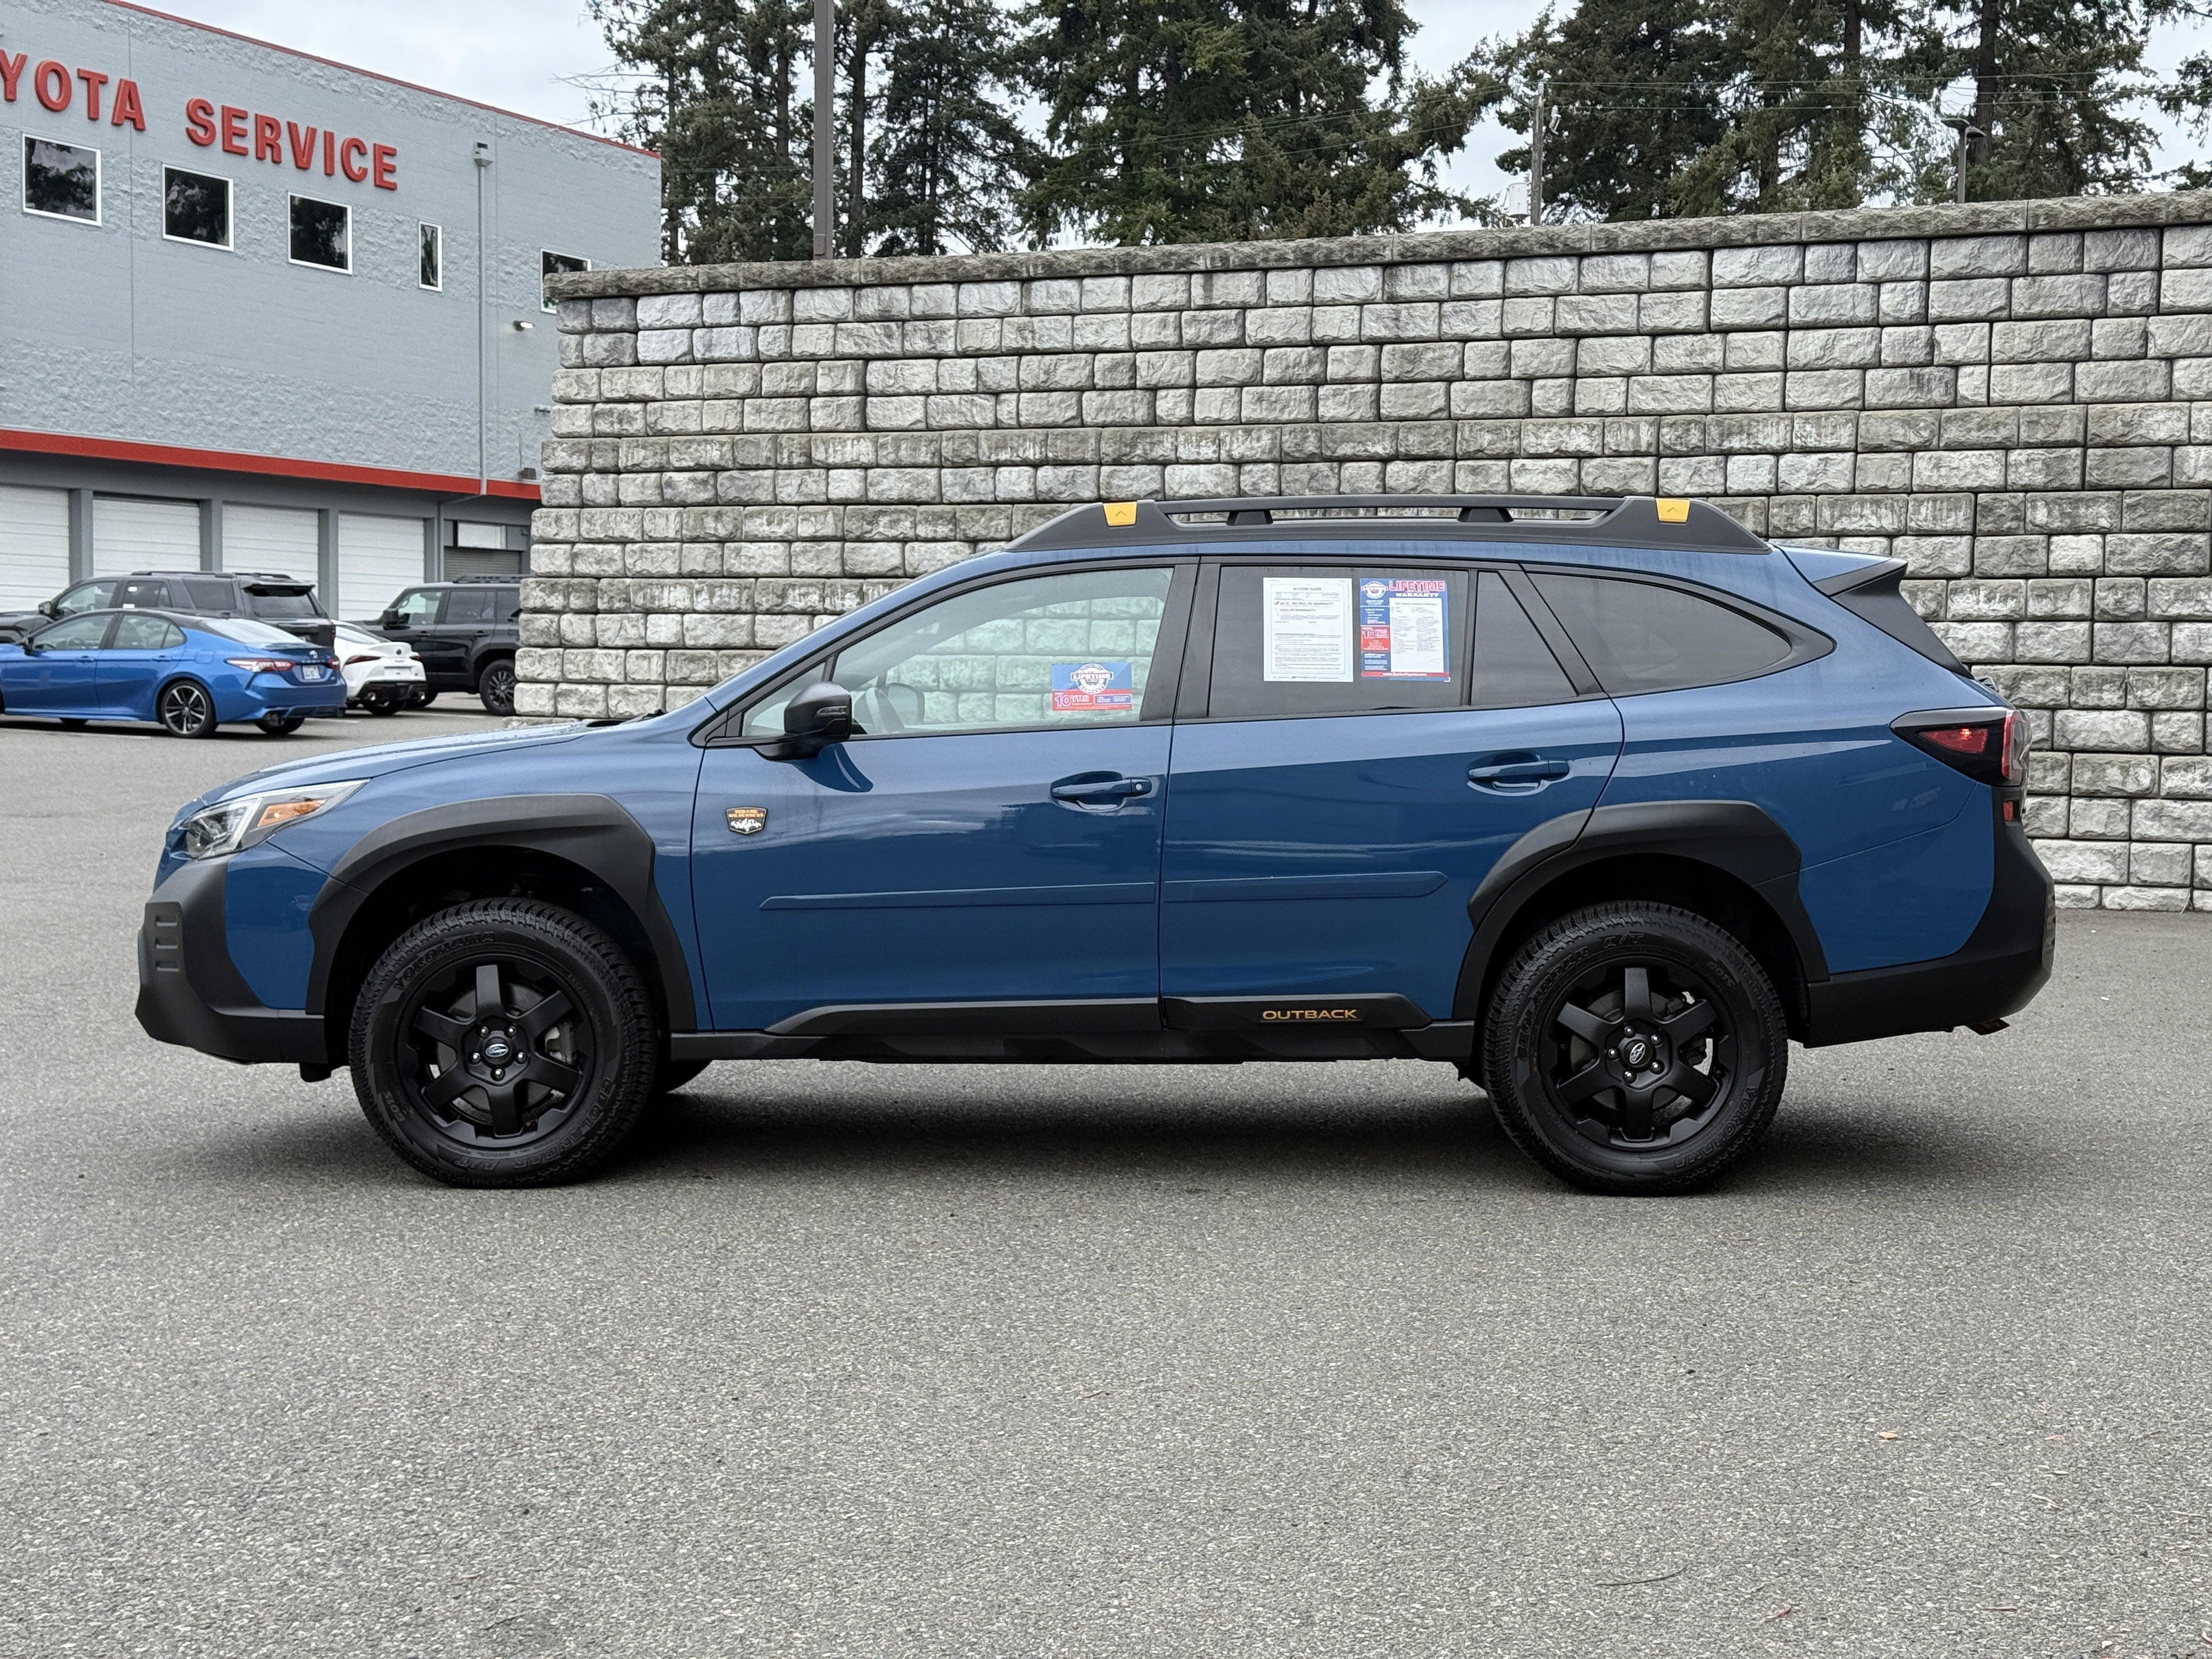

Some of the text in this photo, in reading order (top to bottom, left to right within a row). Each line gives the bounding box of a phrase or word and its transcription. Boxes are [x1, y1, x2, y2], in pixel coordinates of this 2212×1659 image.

[185, 97, 398, 191] SERVICE
[1389, 580, 1446, 591] LIFETIME
[1363, 629, 1377, 639] 10
[1055, 695, 1071, 707] 10
[393, 931, 495, 990] YOKOHAMA
[1262, 1009, 1358, 1020] OUTBACK
[1517, 932, 1645, 1062] GEOLANDAR A/T
[1674, 1086, 1757, 1170] YOKOHAMA
